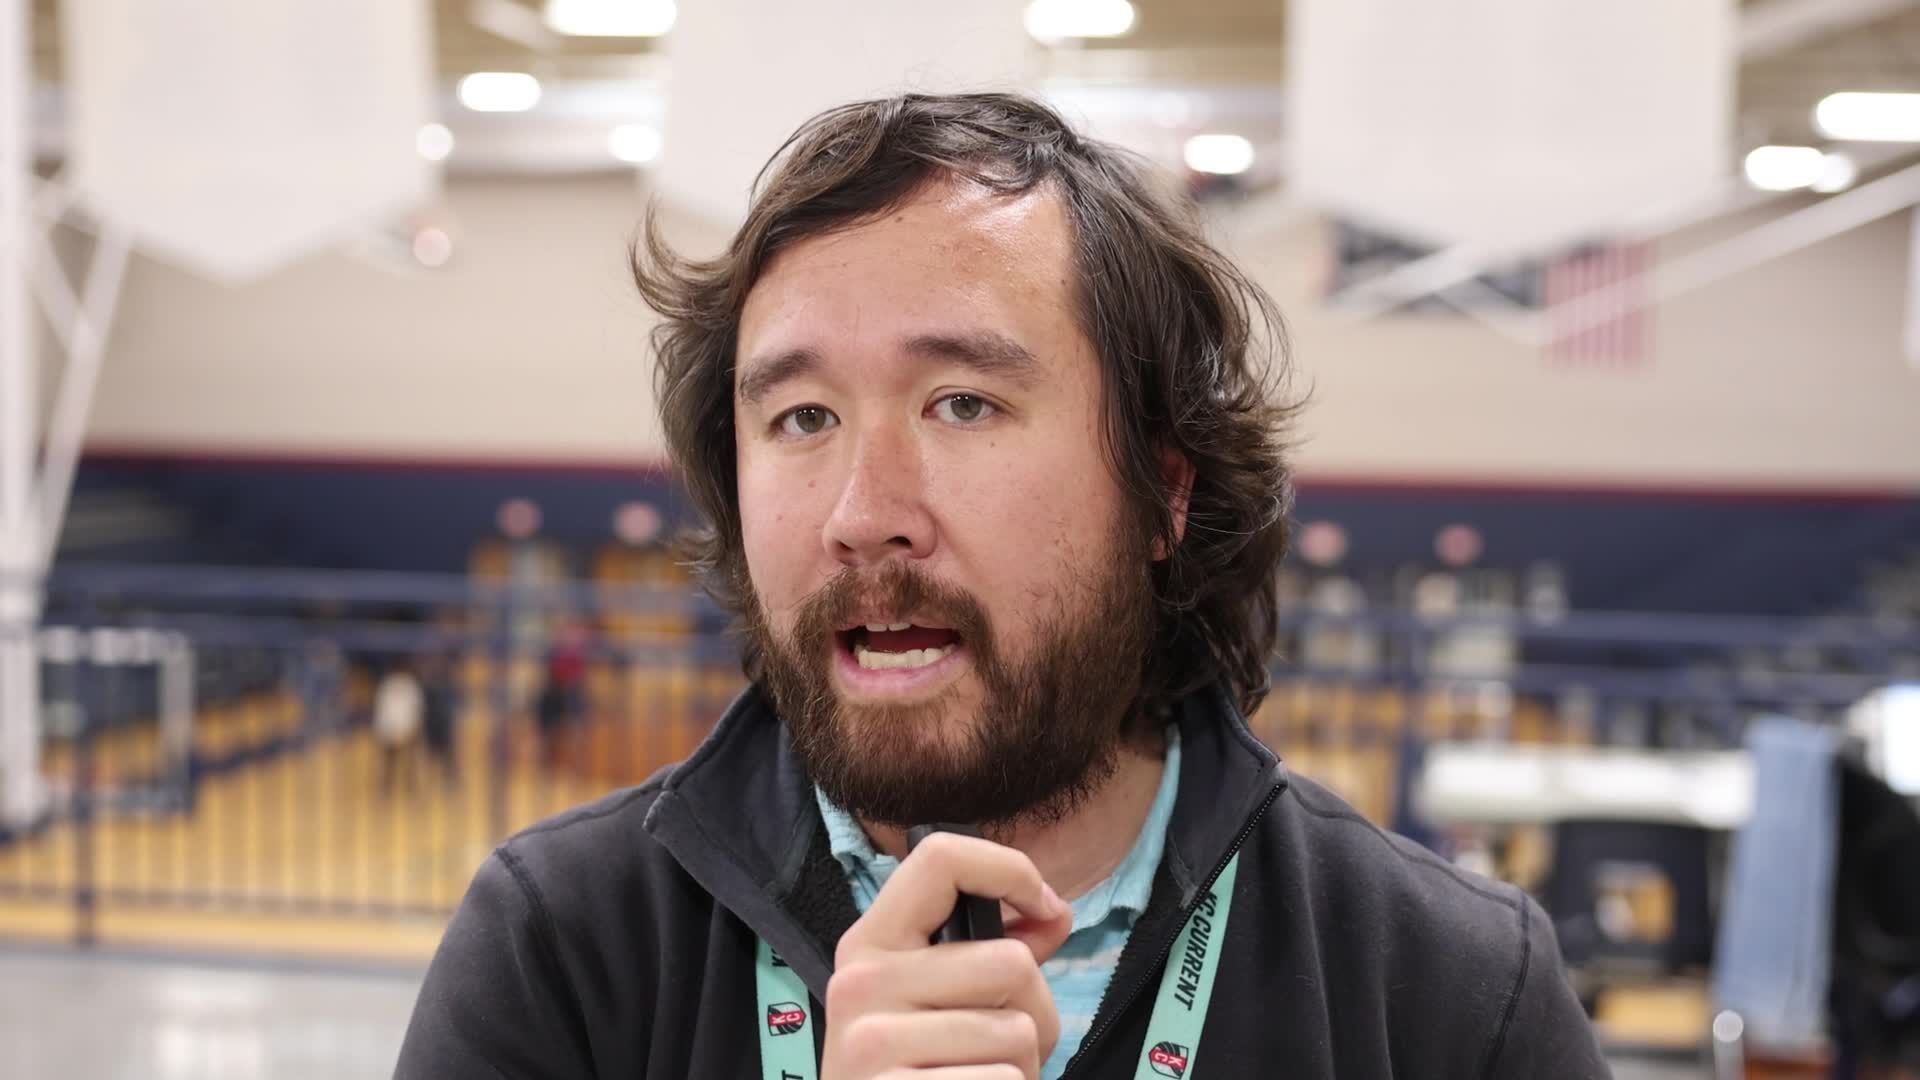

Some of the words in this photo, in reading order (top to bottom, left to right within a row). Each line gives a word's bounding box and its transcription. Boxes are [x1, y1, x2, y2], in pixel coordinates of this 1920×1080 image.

[1174, 915, 1212, 1011] CURRENT
[772, 1014, 801, 1024] KC
[1155, 1052, 1182, 1067] KC
